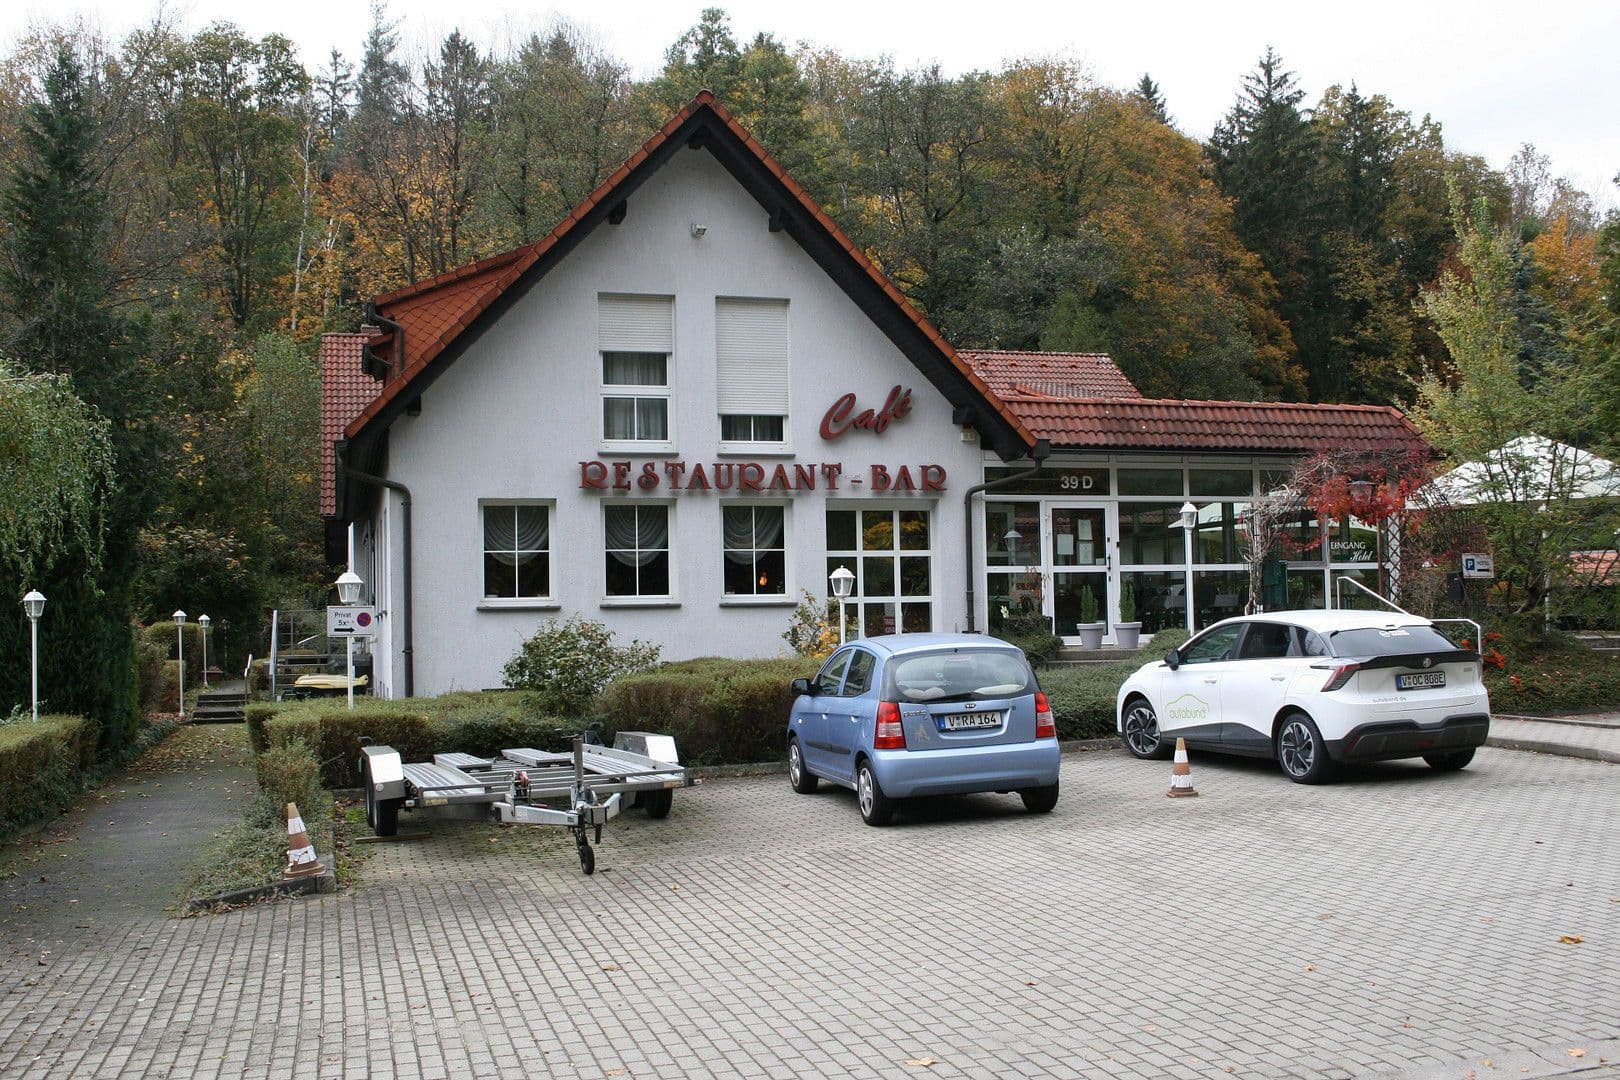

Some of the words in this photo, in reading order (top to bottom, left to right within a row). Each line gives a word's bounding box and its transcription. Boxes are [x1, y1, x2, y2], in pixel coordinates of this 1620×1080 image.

[578, 461, 842, 491] RESTAURANT
[870, 464, 947, 491] BAR
[1061, 475, 1079, 489] 39
[1082, 475, 1093, 489] D
[1330, 541, 1366, 550] EINGANG
[334, 611, 352, 619] Privat
[948, 716, 955, 727] V
[962, 714, 976, 726] RA
[978, 712, 997, 725] 164
